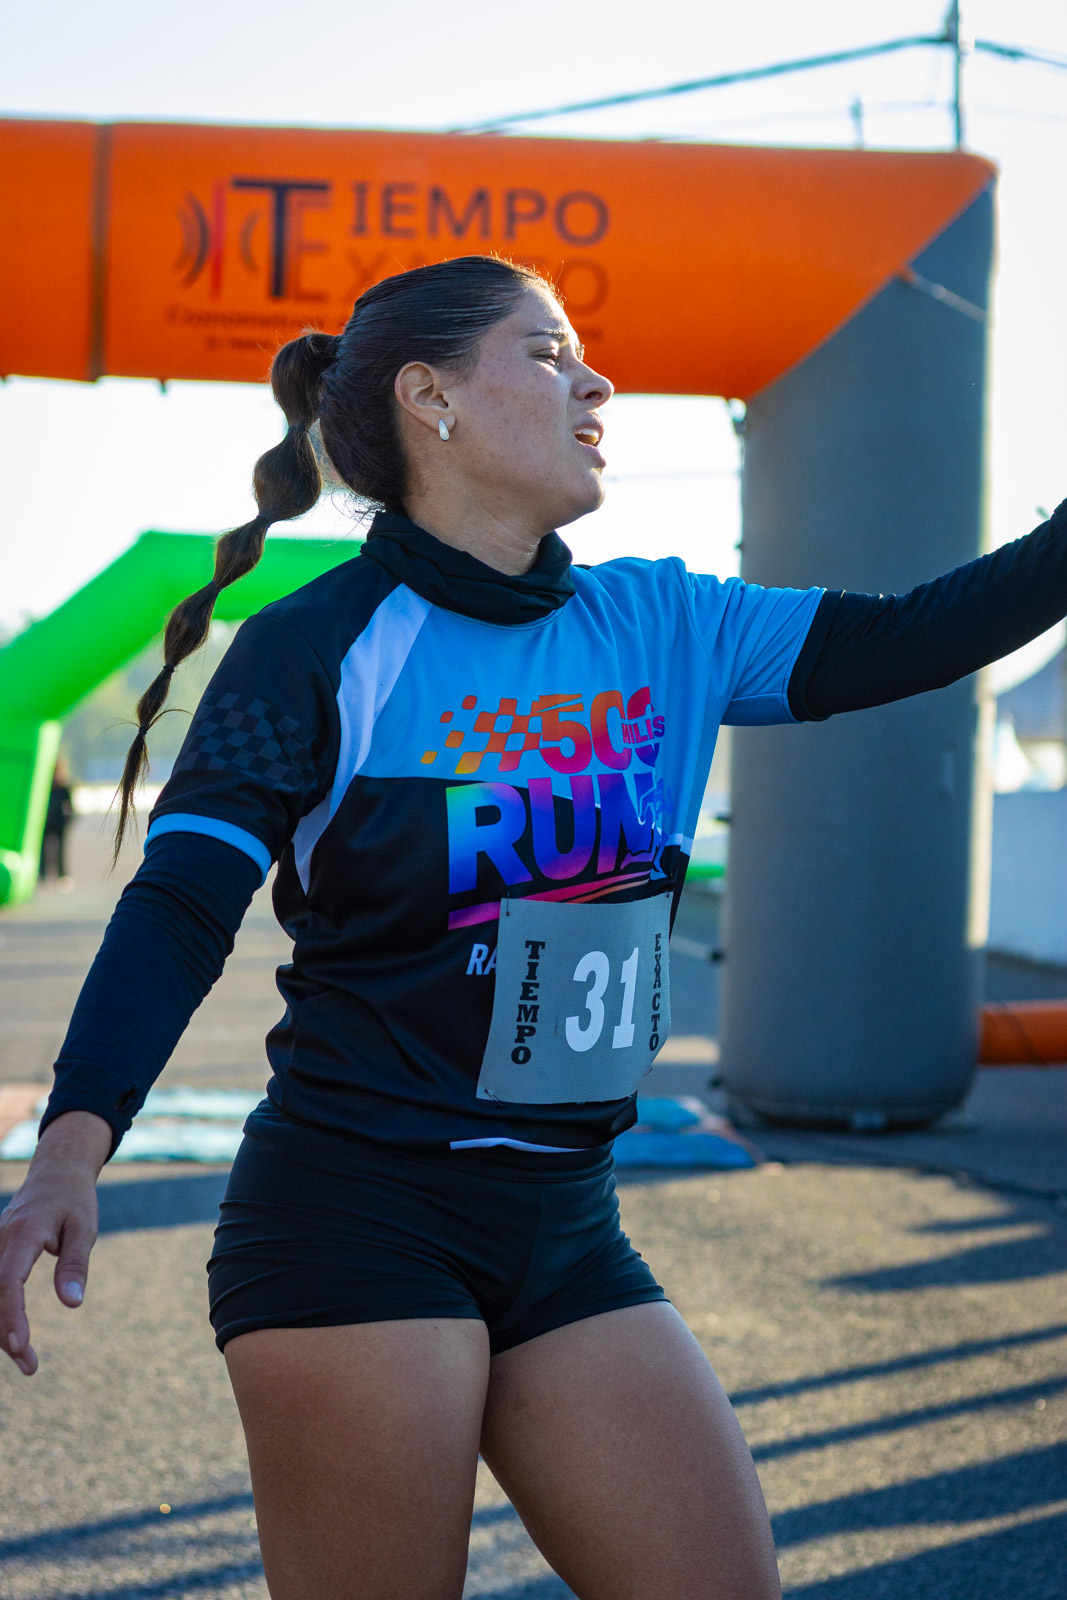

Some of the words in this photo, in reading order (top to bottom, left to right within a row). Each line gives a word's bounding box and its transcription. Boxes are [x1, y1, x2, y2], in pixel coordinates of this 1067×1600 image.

[511, 940, 546, 1065] TIEMPO
[565, 947, 640, 1053] 31
[648, 933, 662, 1052] EXACTO
